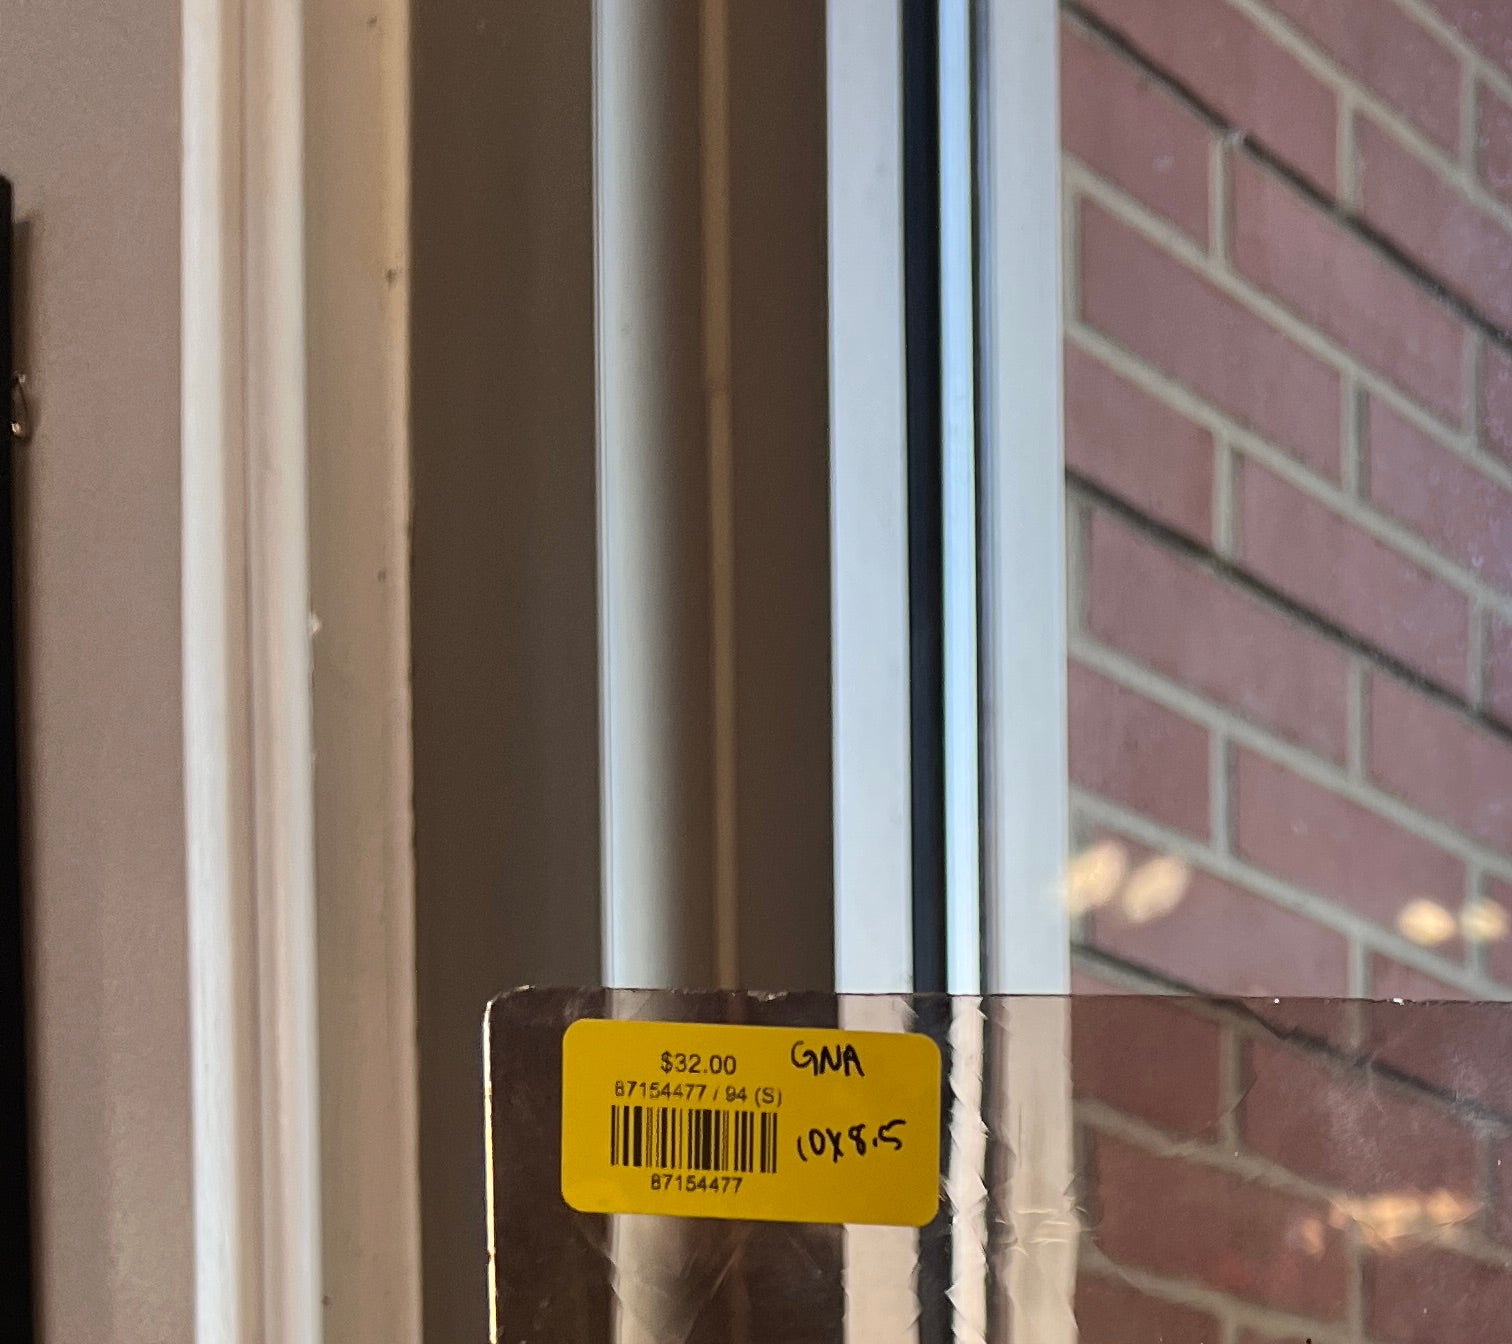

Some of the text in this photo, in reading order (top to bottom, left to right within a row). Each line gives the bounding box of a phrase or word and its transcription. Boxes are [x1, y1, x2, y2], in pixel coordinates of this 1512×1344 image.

[660, 1050, 737, 1076] $32.00
[790, 1040, 866, 1077] GNA
[615, 1080, 707, 1102] 87154477
[754, 1086, 783, 1108] (S)
[650, 1173, 744, 1194] 87154477
